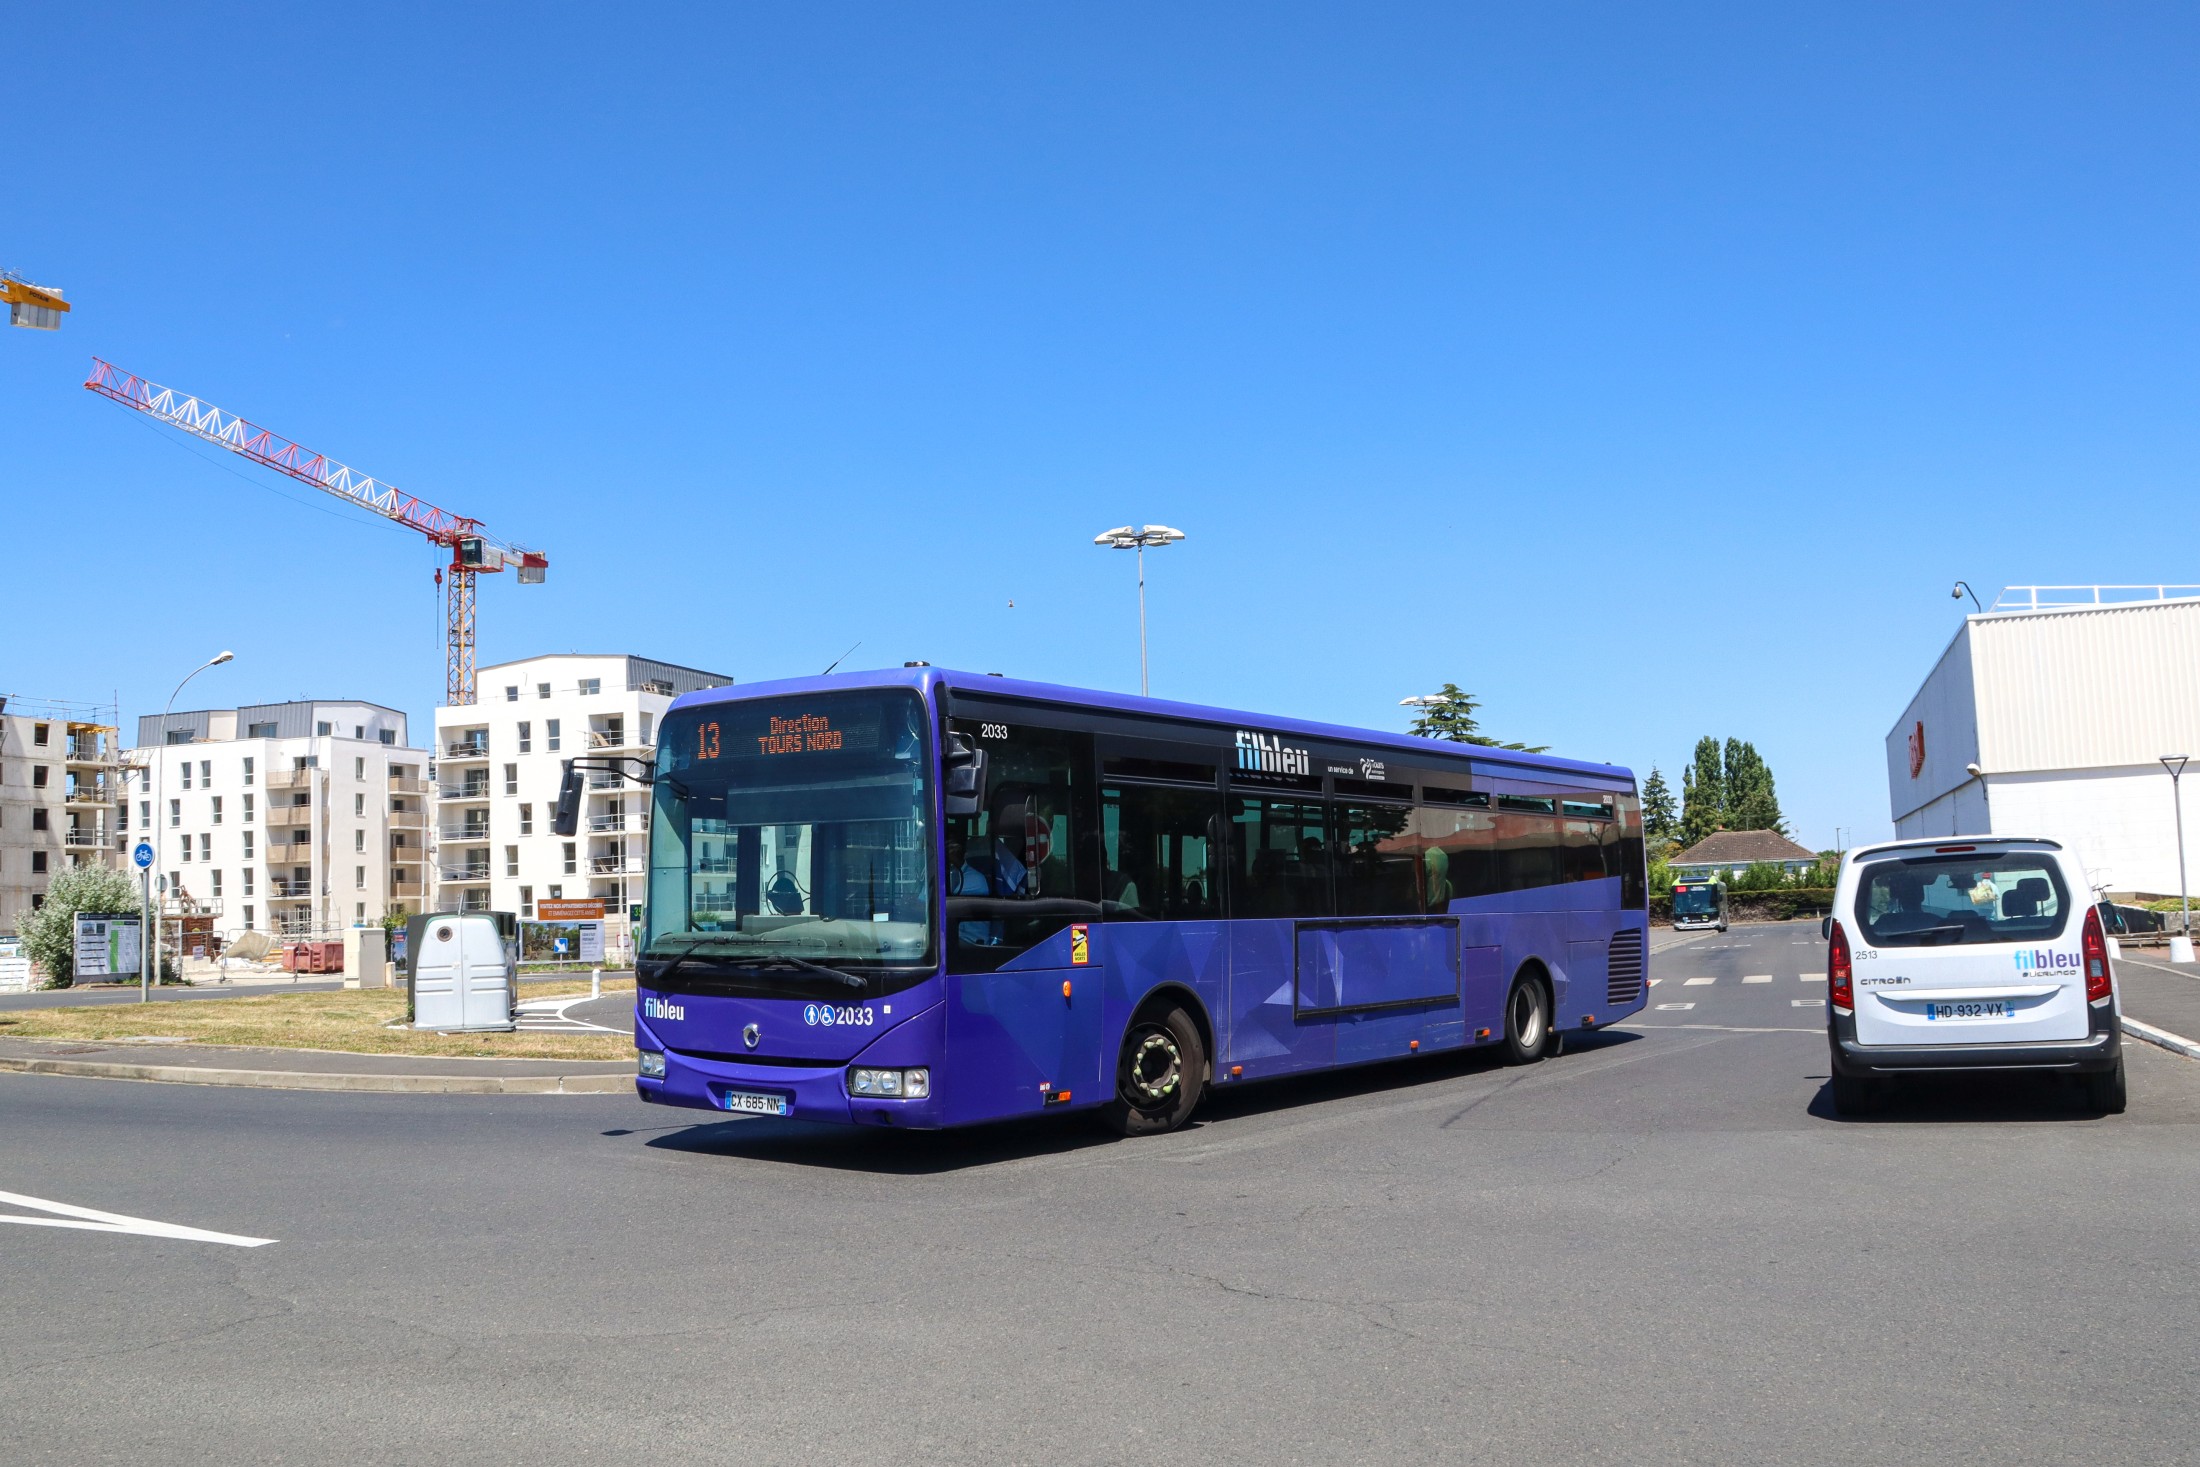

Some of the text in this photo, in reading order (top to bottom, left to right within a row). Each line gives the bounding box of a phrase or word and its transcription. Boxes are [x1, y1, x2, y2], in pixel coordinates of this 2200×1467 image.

[770, 713, 829, 735] Direction
[981, 723, 1008, 740] 2033
[697, 722, 720, 759] 13
[757, 730, 842, 755] TOURS NORD
[1235, 730, 1310, 775] filbleu
[1855, 950, 1878, 960] 2513
[2013, 949, 2081, 971] filbleu
[644, 997, 685, 1021] filbleu
[836, 1006, 874, 1026] 2033
